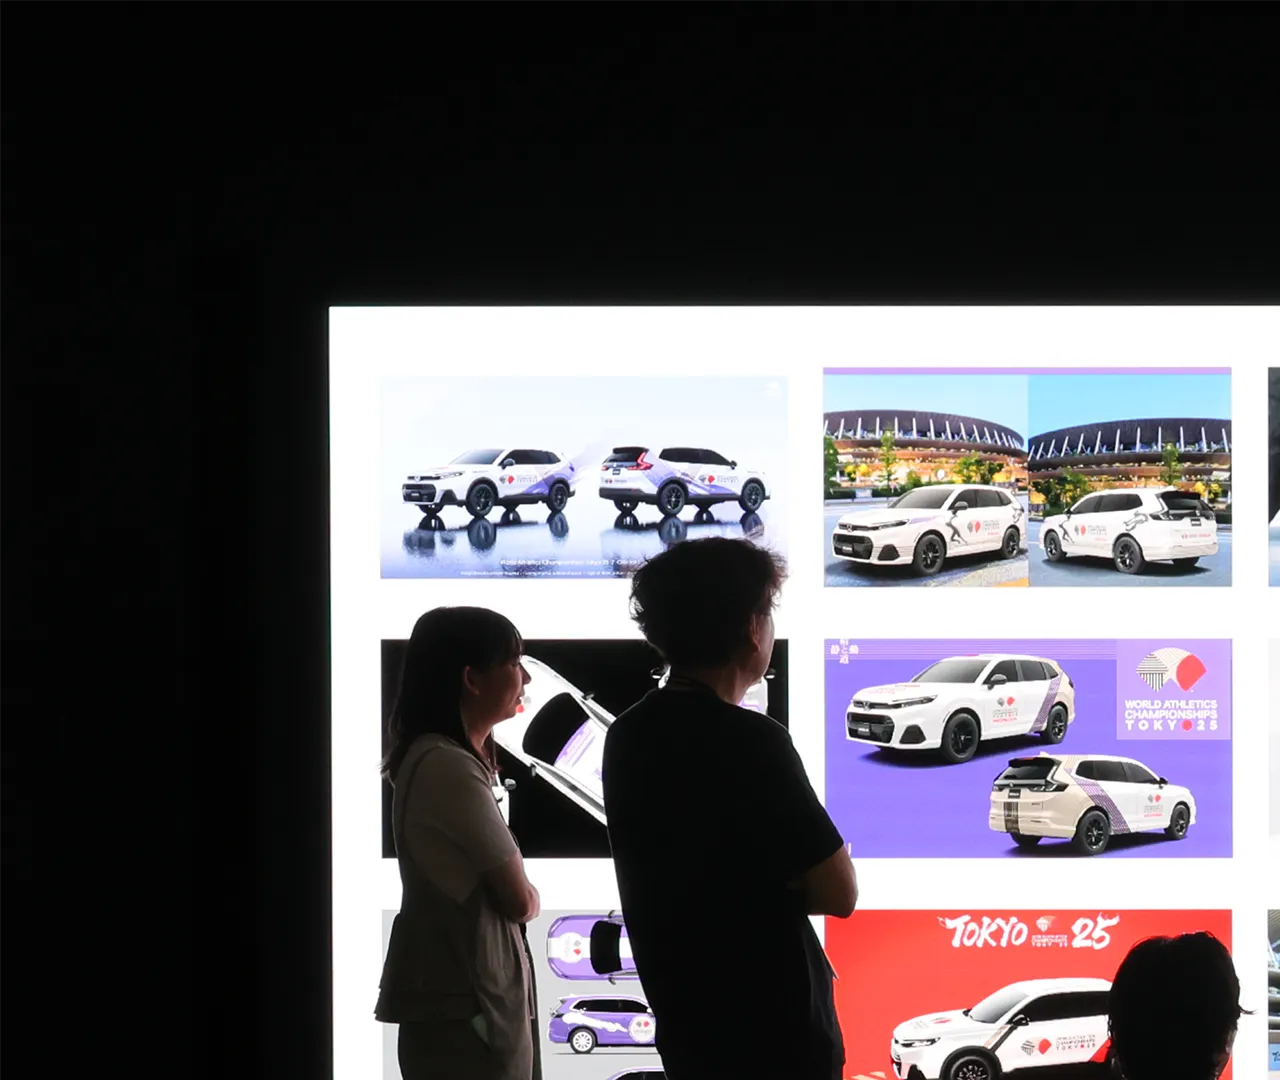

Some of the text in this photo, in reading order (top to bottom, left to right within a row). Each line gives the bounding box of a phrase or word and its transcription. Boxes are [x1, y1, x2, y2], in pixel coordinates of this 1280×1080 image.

[1125, 700, 1218, 709] WORLD ATHLETICS
[1125, 709, 1218, 719] CHAMPIONSHIPS
[1196, 720, 1218, 731] 25
[937, 911, 1120, 950] TOKYO 25
